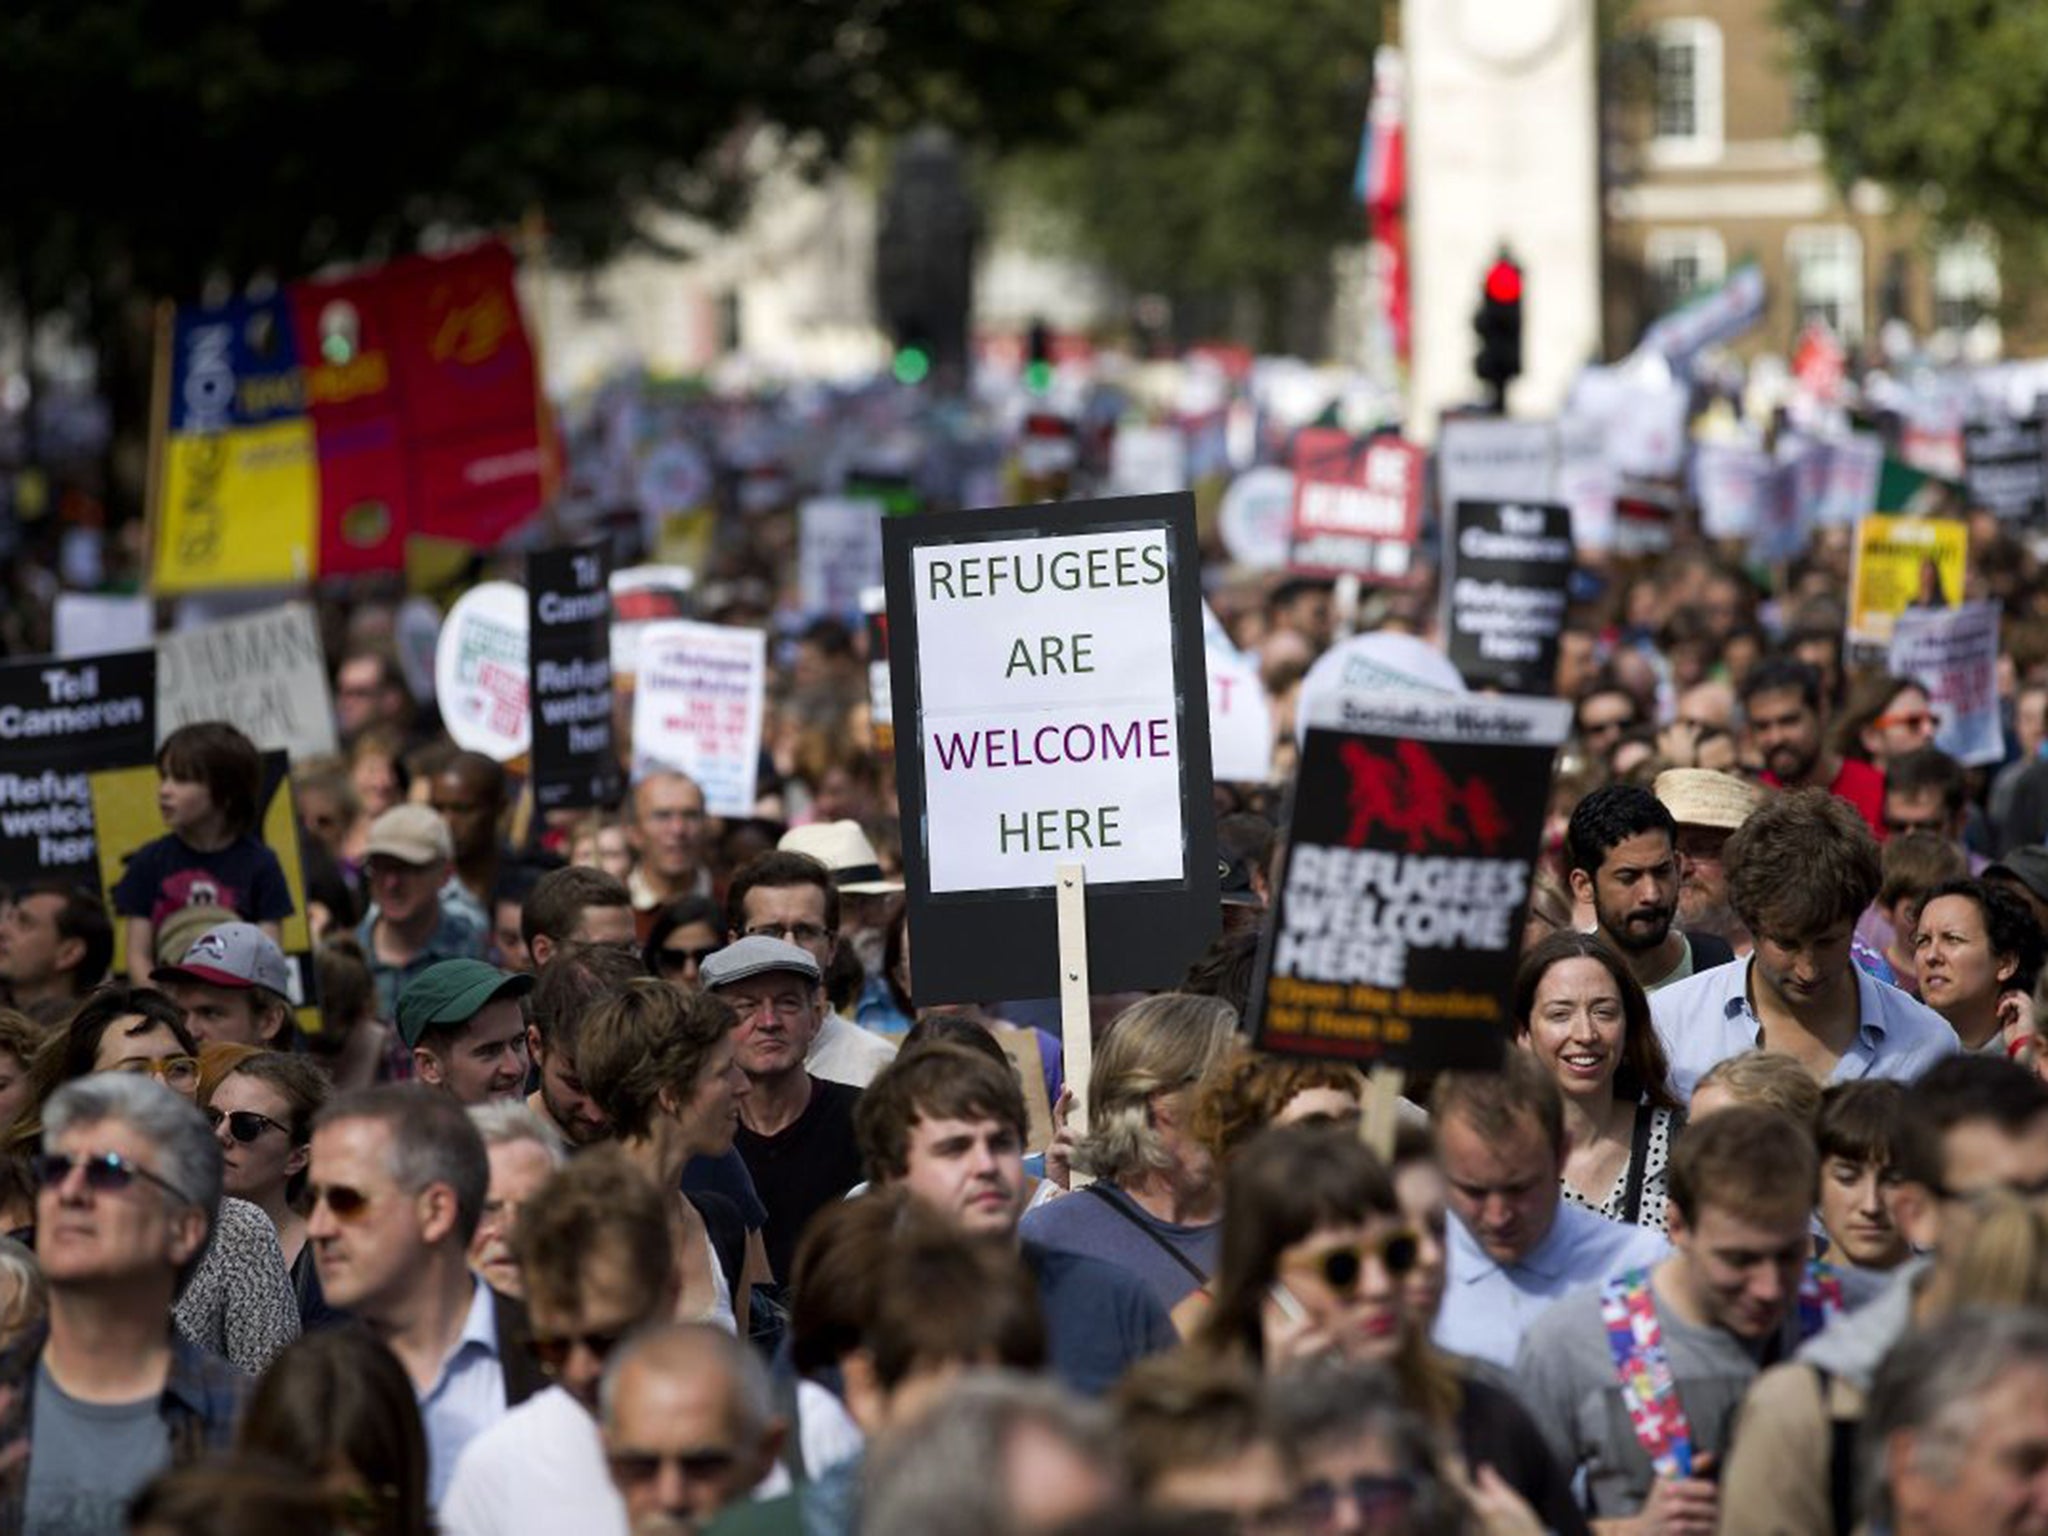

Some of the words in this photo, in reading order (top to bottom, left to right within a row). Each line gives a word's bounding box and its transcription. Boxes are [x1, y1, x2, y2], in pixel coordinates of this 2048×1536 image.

[929, 545, 1166, 600] REFUGEES
[1005, 633, 1095, 678] ARE
[42, 666, 98, 702] Tell
[0, 697, 144, 740] Cameron
[934, 718, 1170, 771] WELCOME
[38, 835, 96, 867] her
[1000, 805, 1122, 854] HERE
[1288, 842, 1529, 905] REFUGEES
[1284, 890, 1512, 949] WELCOME
[1275, 931, 1406, 989] HERE
